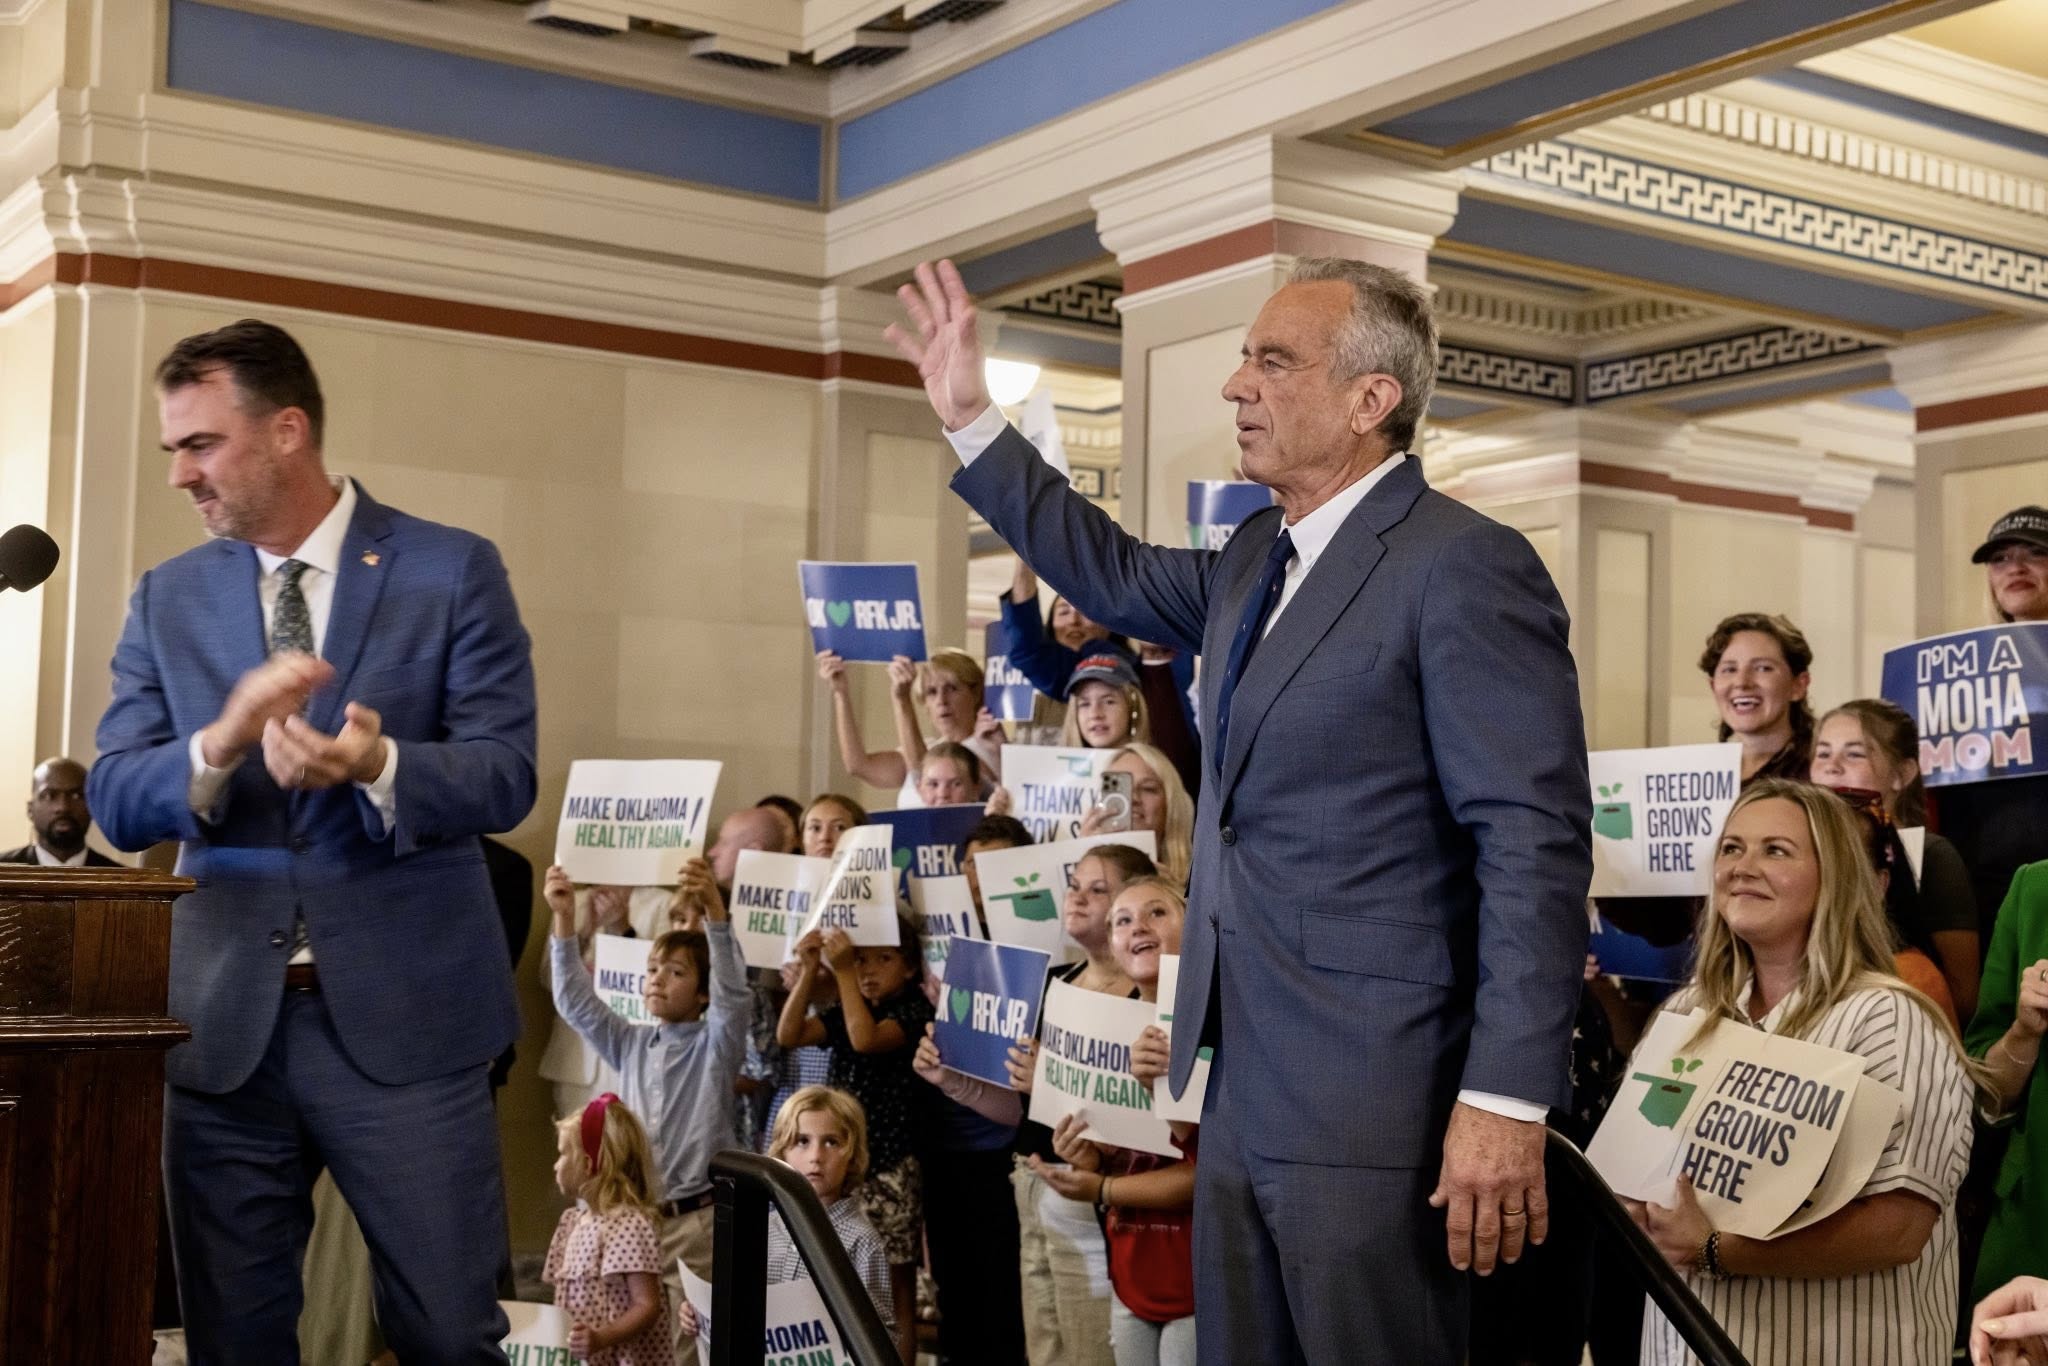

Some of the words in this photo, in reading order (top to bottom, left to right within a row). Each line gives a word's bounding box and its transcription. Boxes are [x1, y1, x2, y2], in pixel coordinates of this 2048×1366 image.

[853, 599, 889, 630] RFK
[889, 599, 921, 630] JR.
[1917, 639, 1978, 684] I'M
[1987, 634, 2023, 673] A
[1917, 671, 2030, 738] MOHA
[1918, 726, 2033, 776] MOM
[1022, 783, 1085, 815] THANK
[1645, 770, 1734, 804] FREEDOM
[566, 797, 612, 820] MAKE
[615, 797, 688, 822] OKLAHOMA
[1647, 806, 1712, 838] GROWS
[575, 823, 647, 849] HEALTHY
[916, 844, 959, 876] RFK
[1649, 842, 1696, 872] HERE
[737, 883, 784, 911] MAKE
[599, 968, 635, 995] MAKE
[972, 991, 1001, 1035] RFK
[1001, 998, 1030, 1046] JR.
[1045, 1055, 1091, 1099] HEALTHY
[1094, 1073, 1152, 1111] AGAIN
[1716, 1060, 1845, 1131] FREEDOM
[1694, 1100, 1796, 1167] GROWS
[1682, 1142, 1752, 1204] HERE
